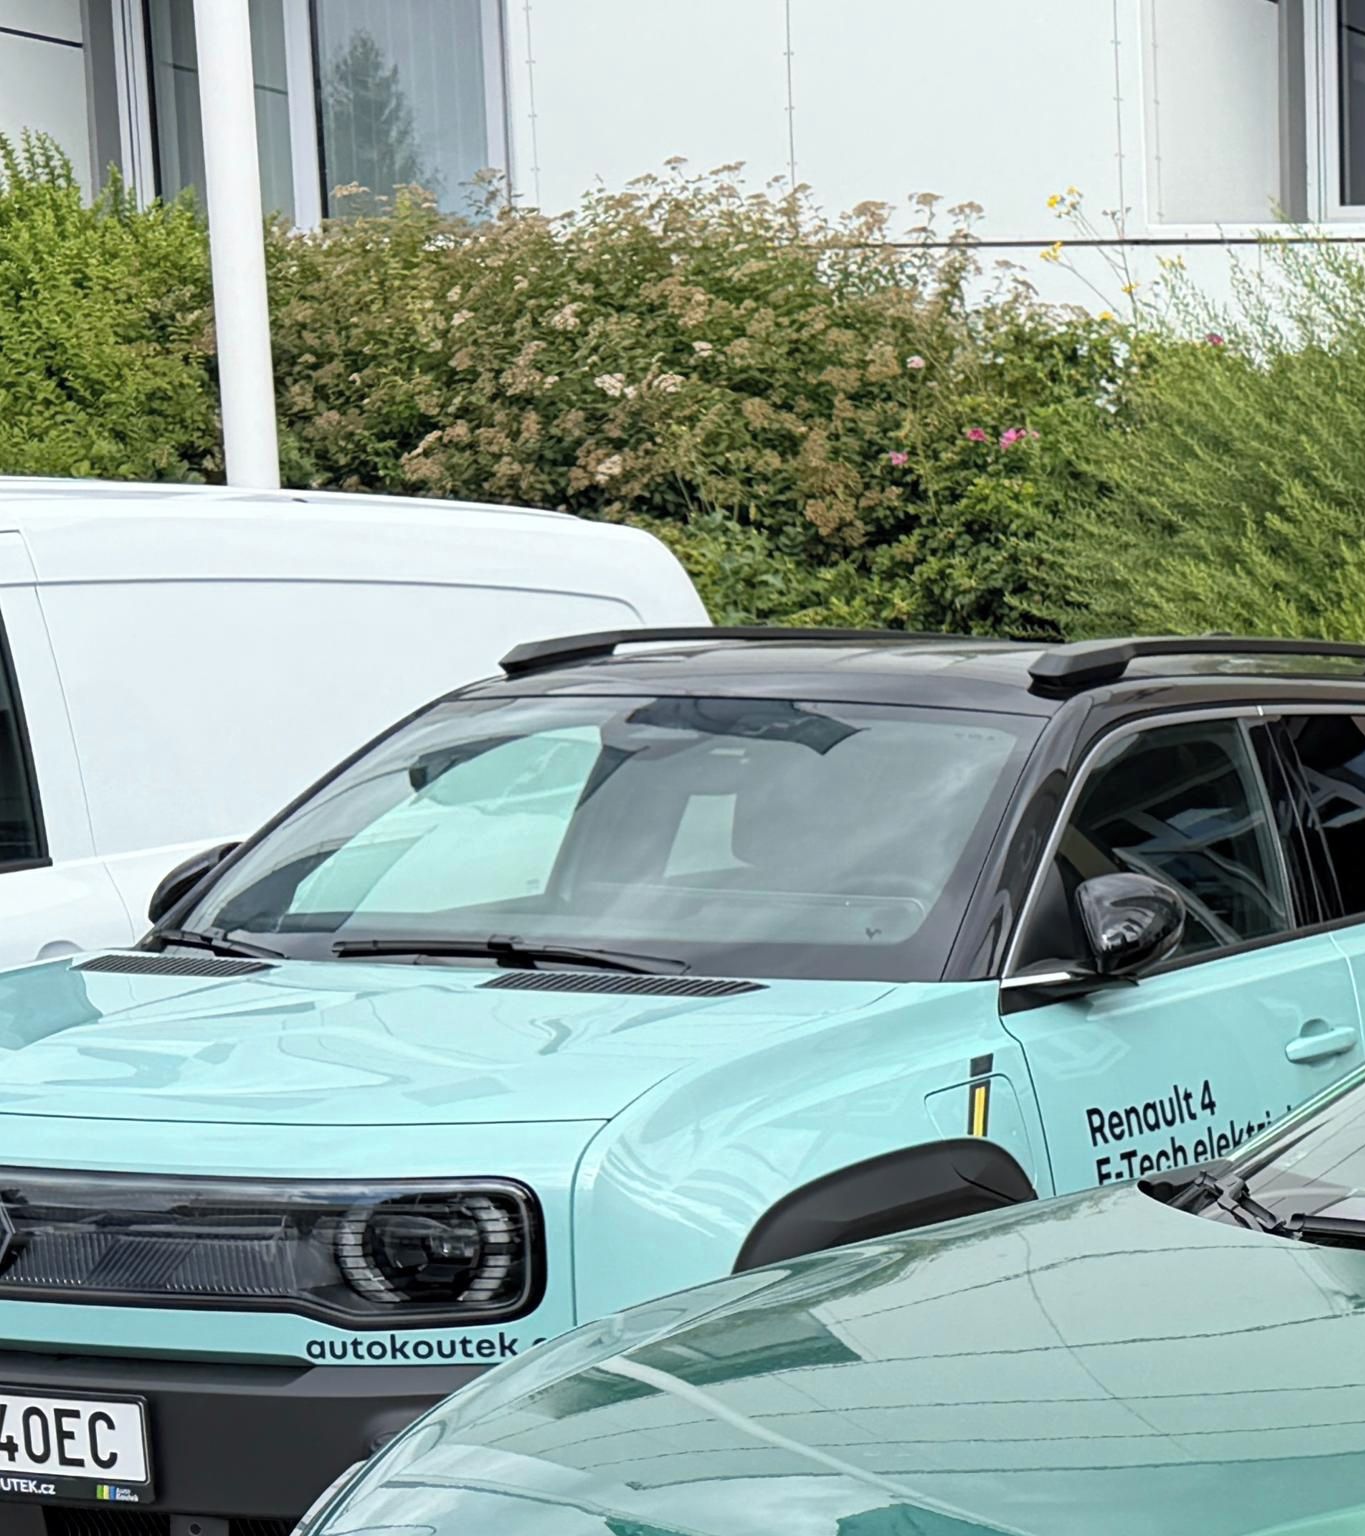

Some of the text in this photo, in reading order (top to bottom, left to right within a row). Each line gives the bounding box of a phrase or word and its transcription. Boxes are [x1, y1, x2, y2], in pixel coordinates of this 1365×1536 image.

[1086, 1079, 1217, 1147] Renault 4
[306, 1332, 547, 1360] autokoutek
